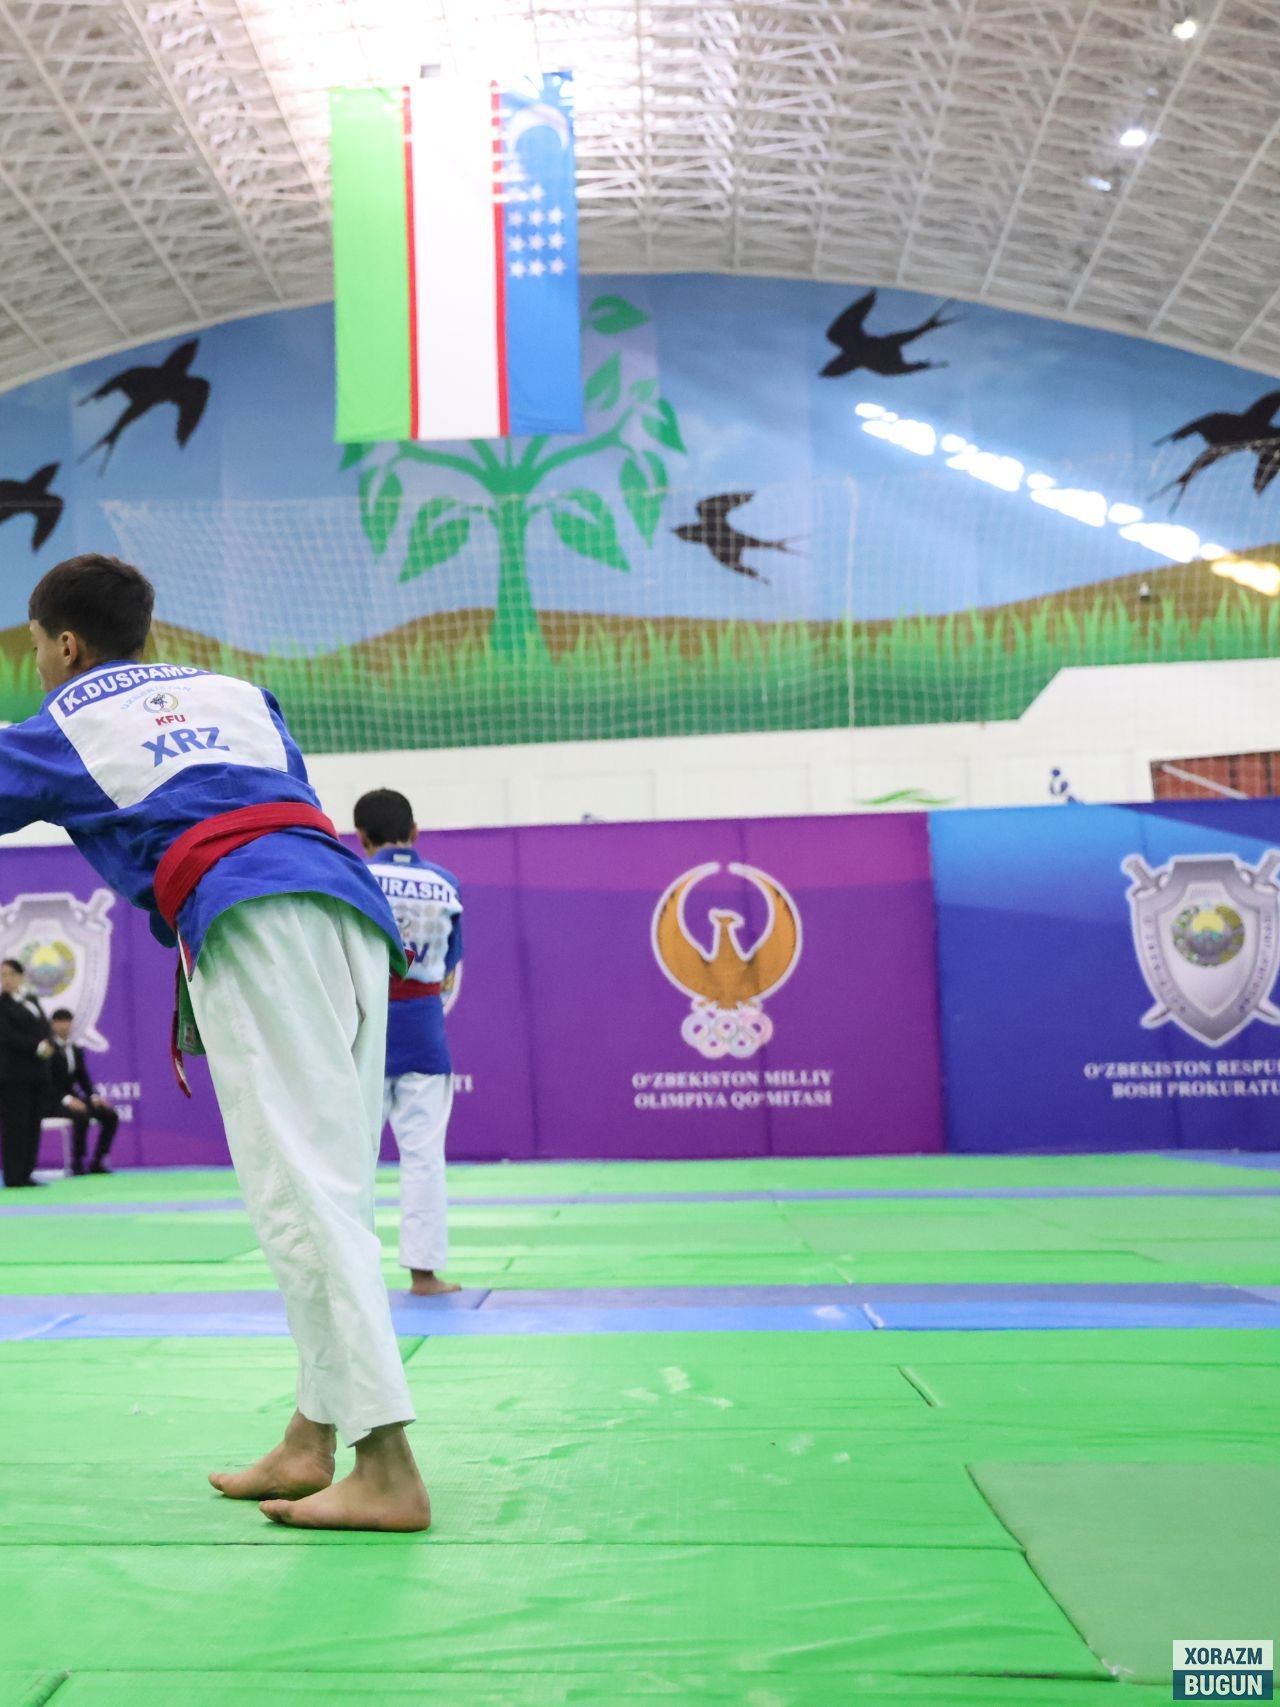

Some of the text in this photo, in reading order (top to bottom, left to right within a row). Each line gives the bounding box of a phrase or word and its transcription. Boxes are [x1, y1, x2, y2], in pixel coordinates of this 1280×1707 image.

[63, 666, 209, 711] K.DUSHAMO
[155, 714, 186, 726] KFU
[141, 727, 230, 767] XRZ
[1216, 1059, 1280, 1077] RESPU
[764, 1069, 833, 1087] MILLIY
[634, 1091, 728, 1110] OLIMPIYA
